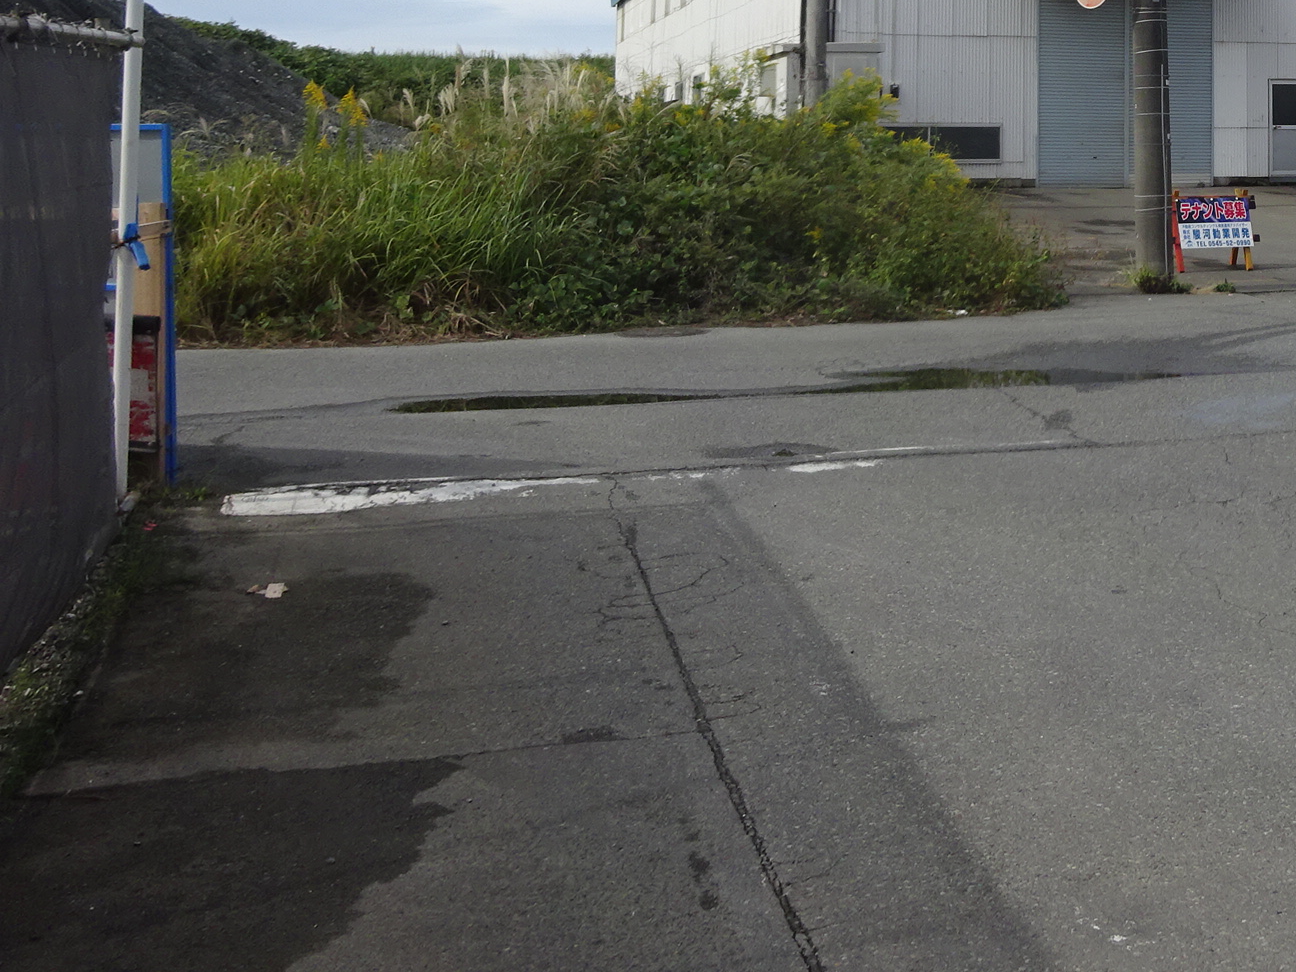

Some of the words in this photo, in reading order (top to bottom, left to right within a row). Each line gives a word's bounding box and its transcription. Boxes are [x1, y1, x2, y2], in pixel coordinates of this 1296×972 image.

[1180, 201, 1246, 220] テナント募集
